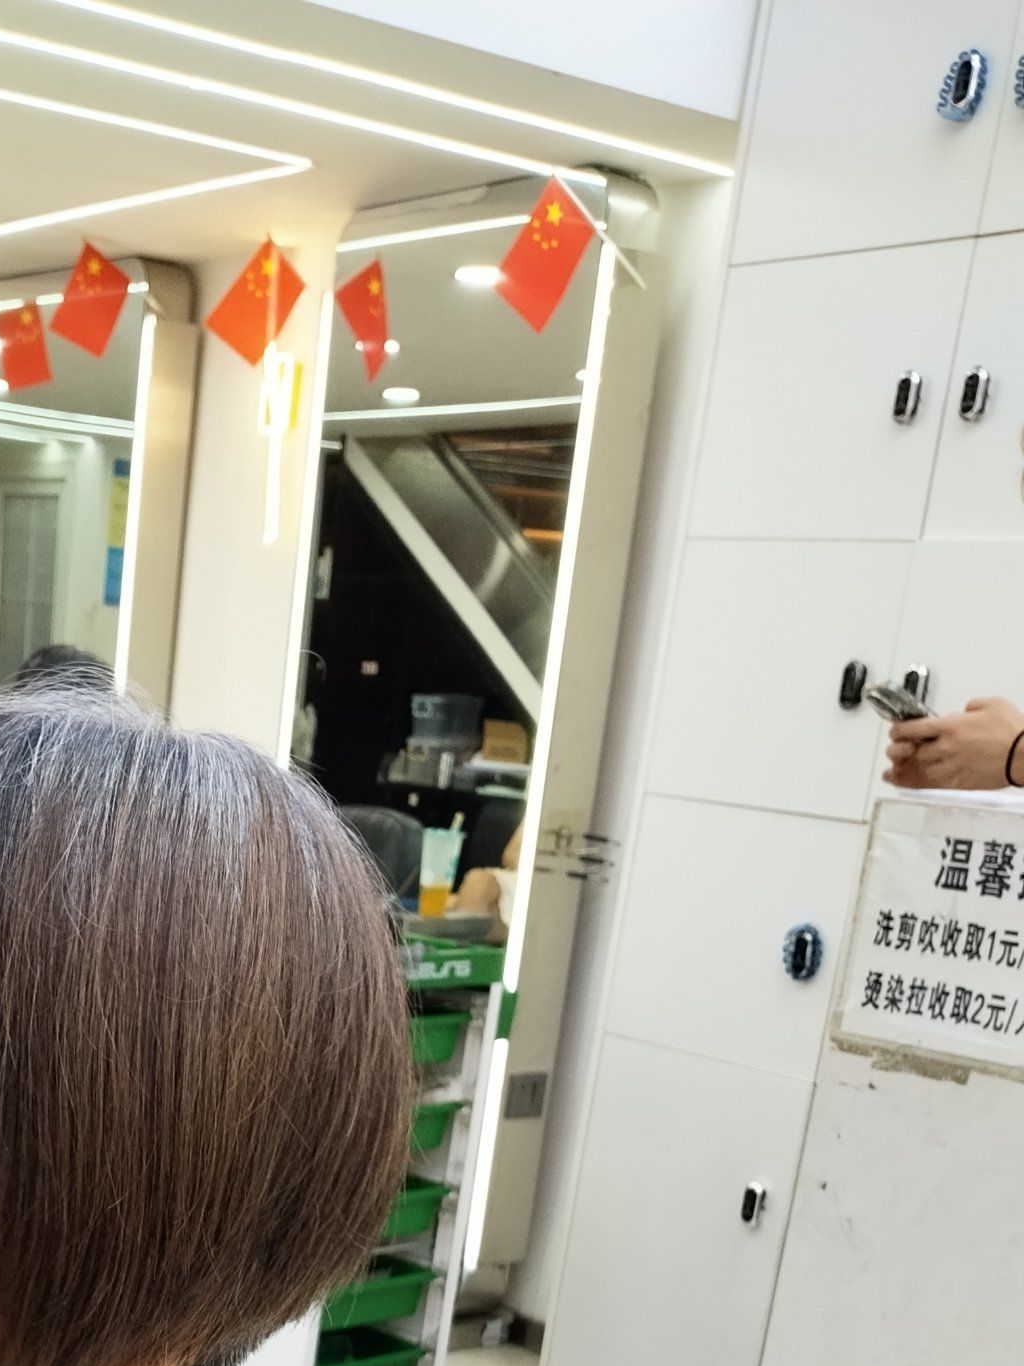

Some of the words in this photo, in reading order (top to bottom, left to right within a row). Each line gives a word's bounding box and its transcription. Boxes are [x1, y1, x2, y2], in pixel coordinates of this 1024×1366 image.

[934, 836, 1024, 901] 温馨
[861, 970, 1024, 1035] 烫染拉收取2元/
